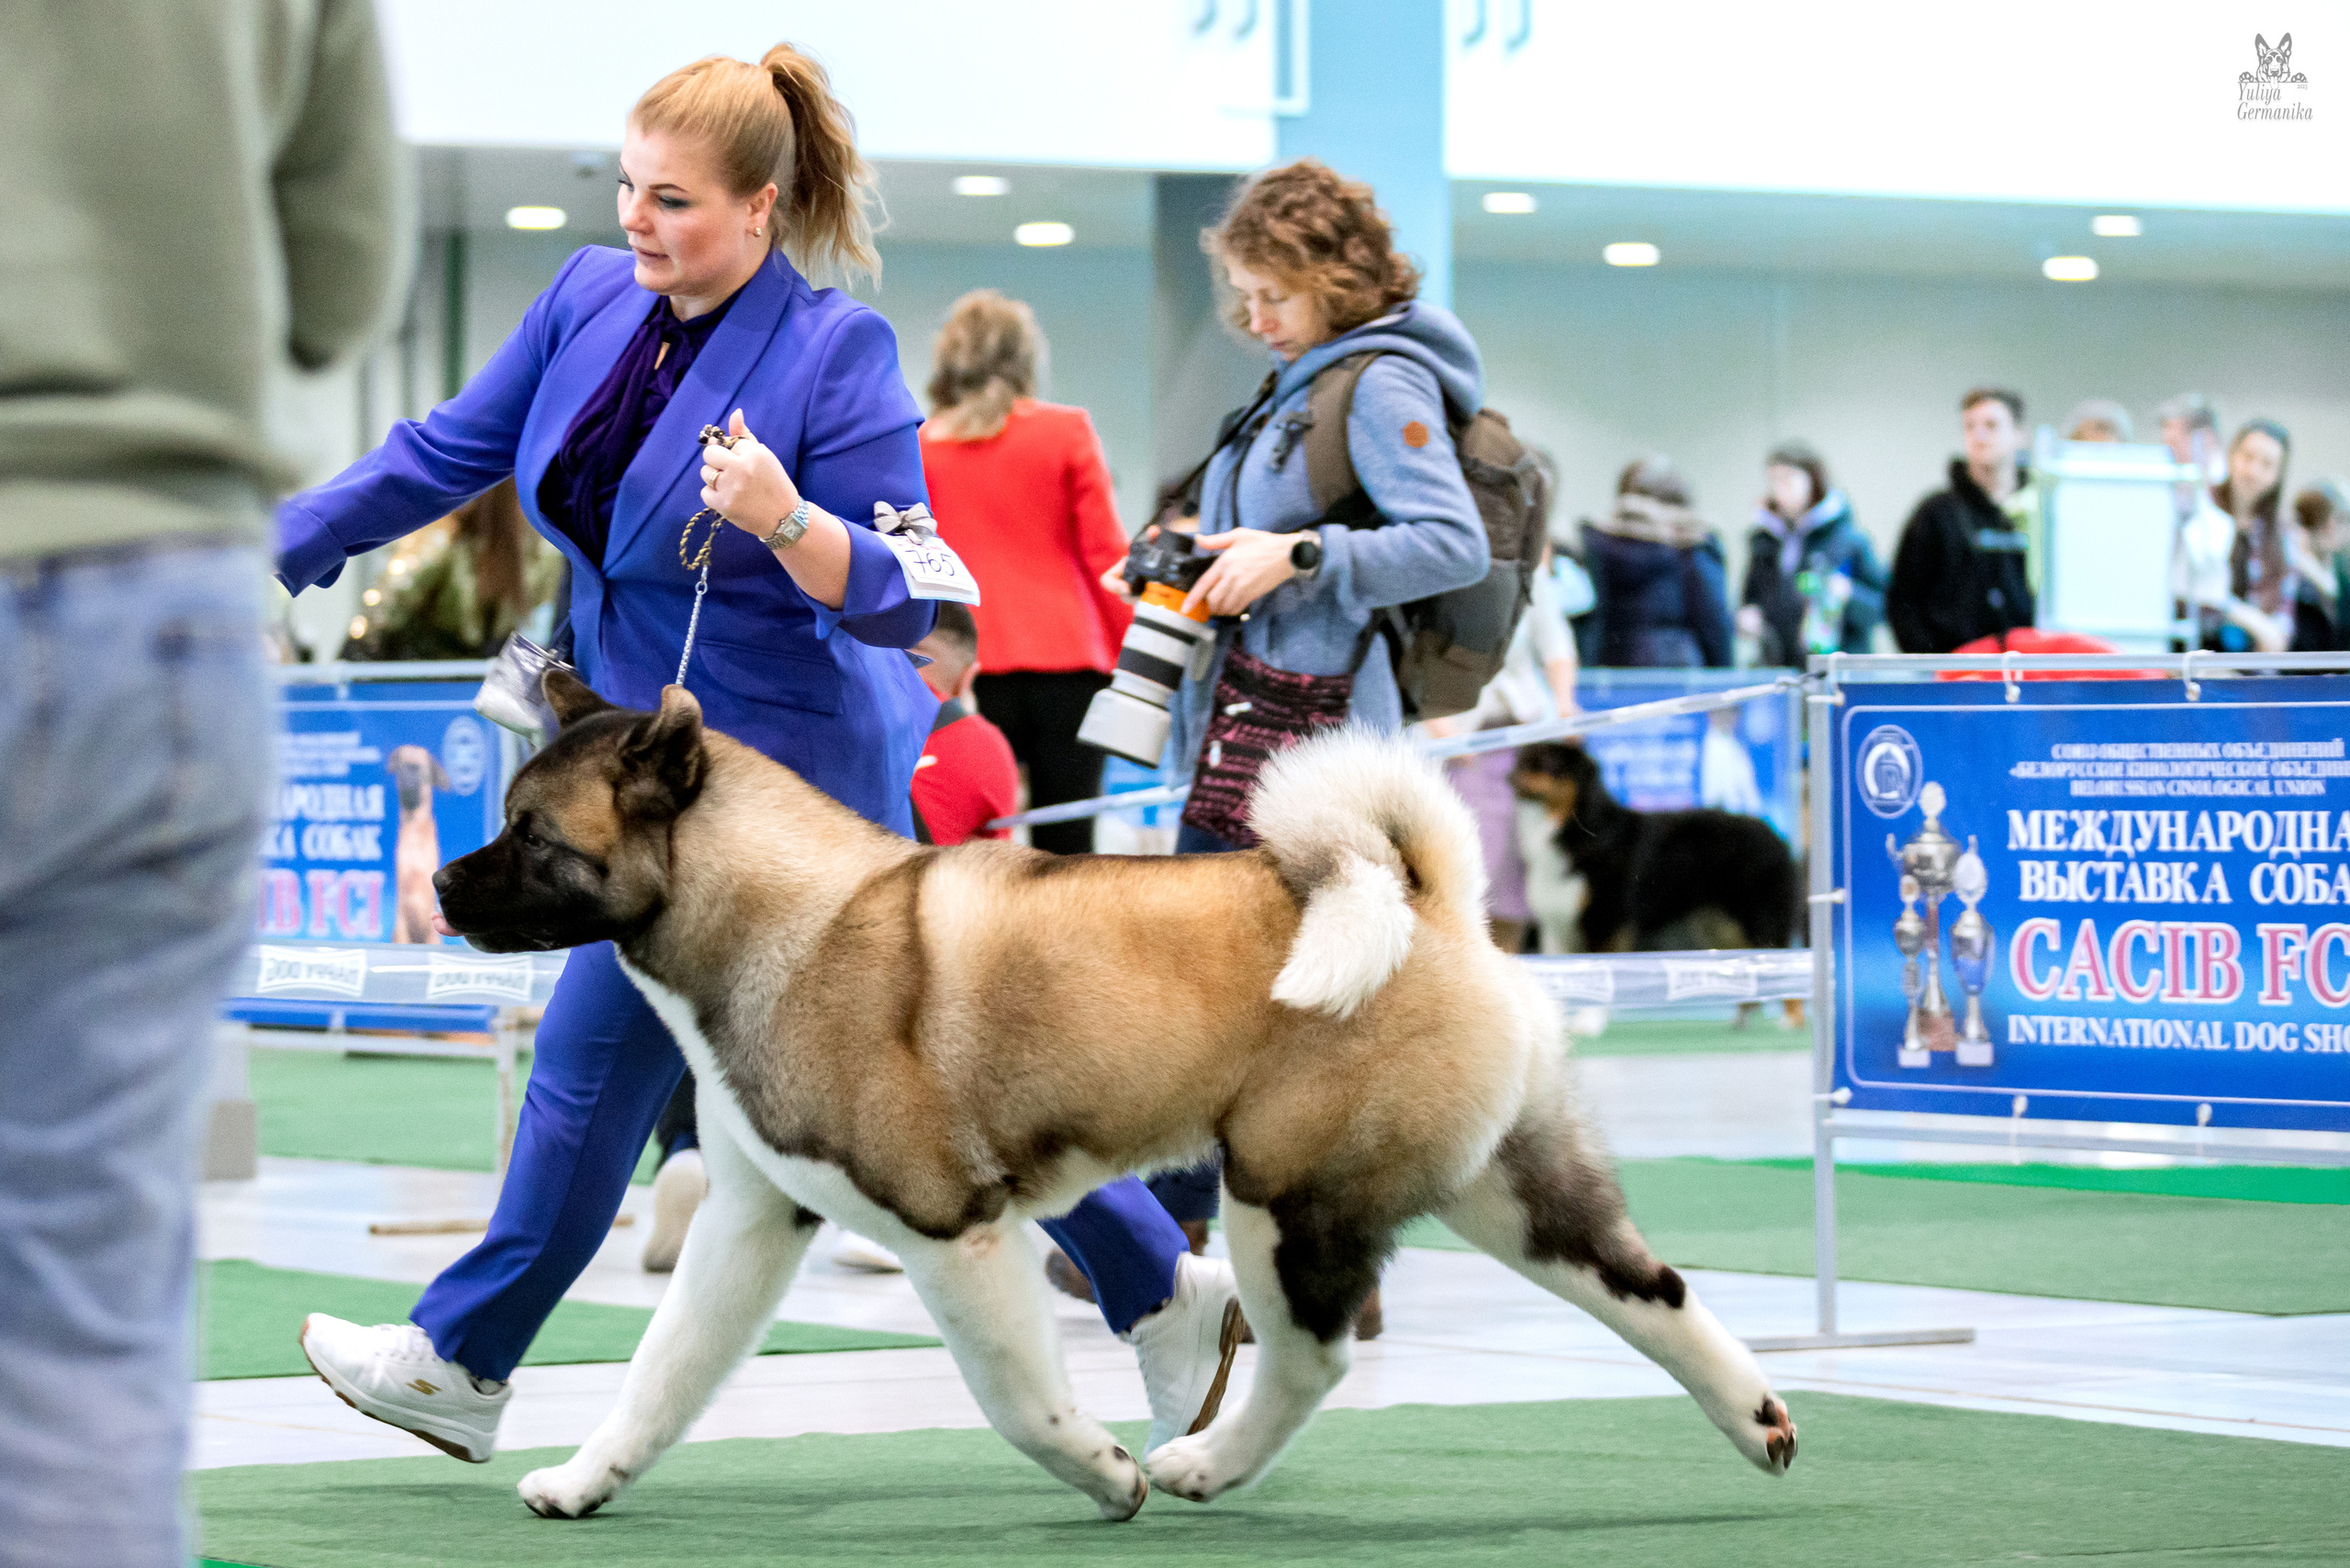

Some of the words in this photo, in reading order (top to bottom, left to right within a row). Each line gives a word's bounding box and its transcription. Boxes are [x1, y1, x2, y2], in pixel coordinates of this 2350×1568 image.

[904, 550, 955, 577] 765
[2018, 859, 2232, 904] ВЫСТАВКА
[2009, 916, 2245, 1004] CACIB
[2255, 922, 2350, 1008] FC
[2007, 1014, 2231, 1050] INTERNATIONAL
[2233, 1020, 2300, 1053] DOG
